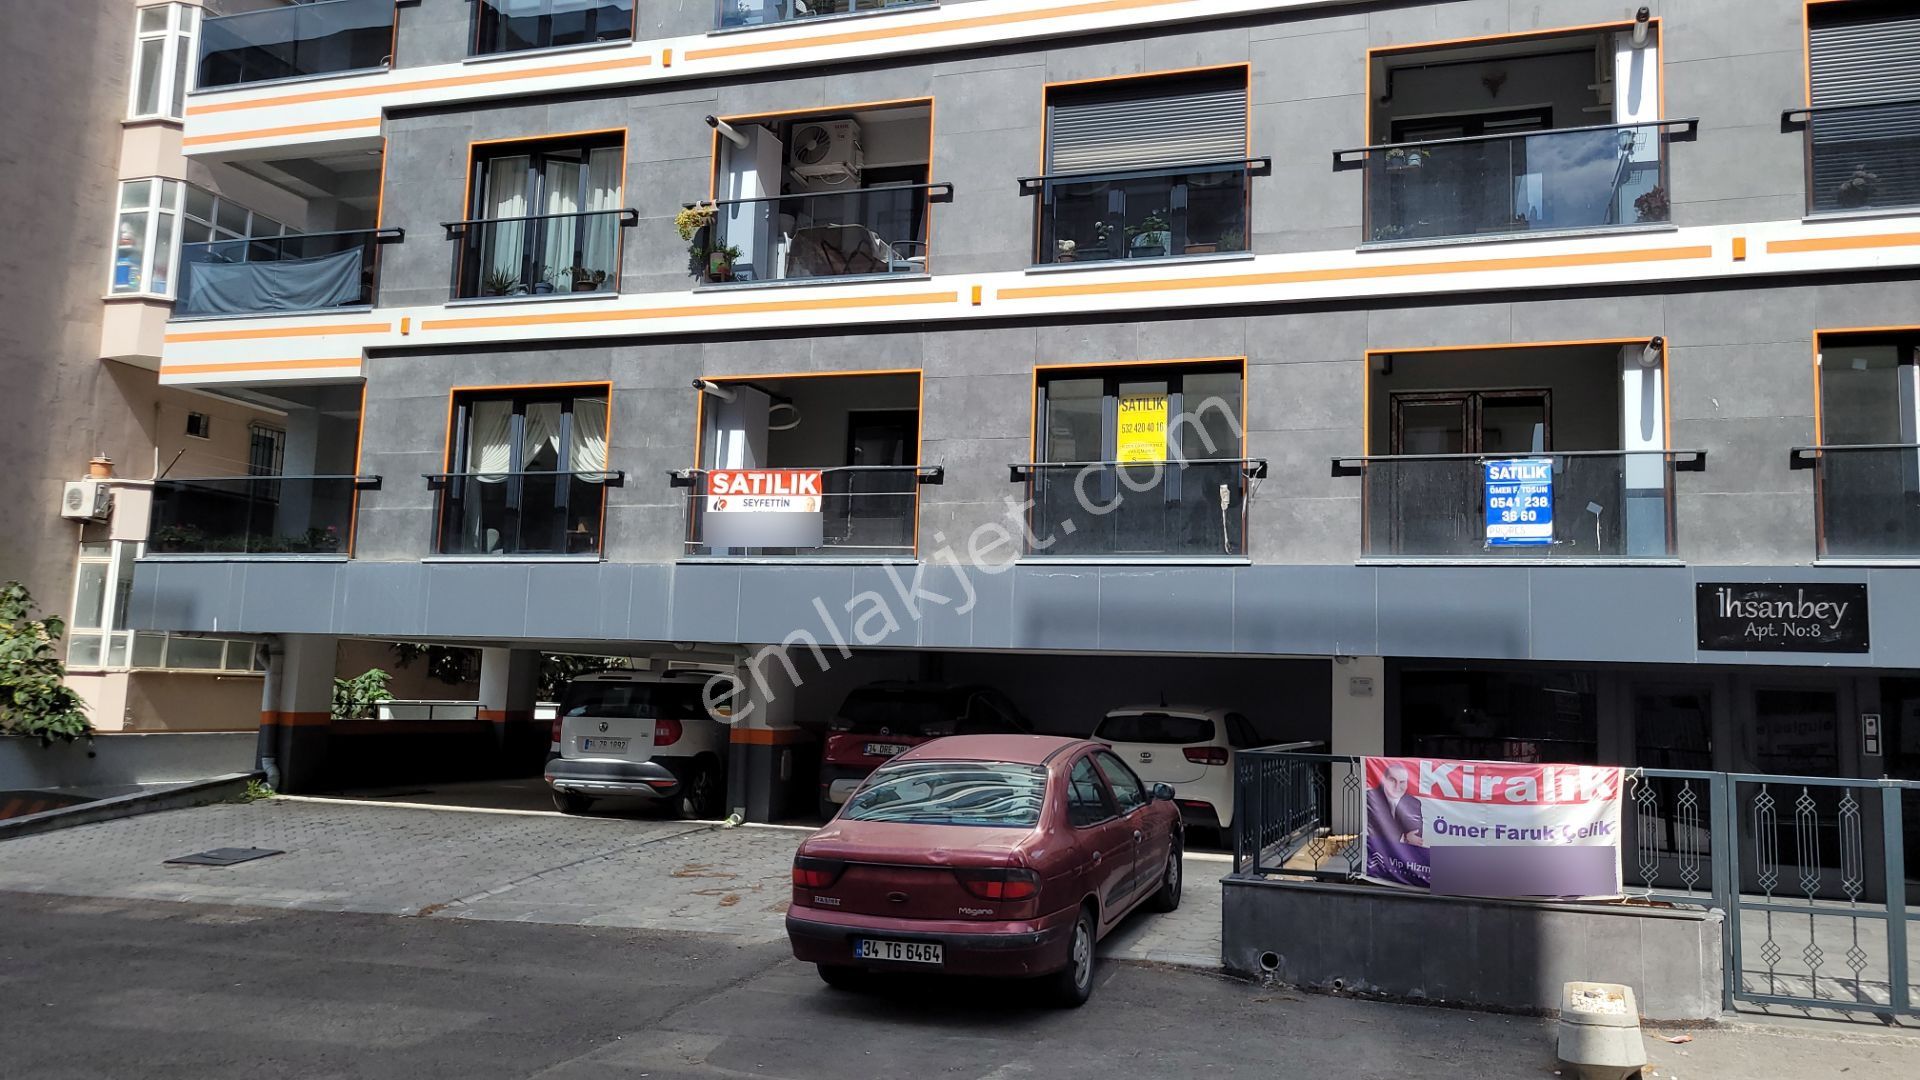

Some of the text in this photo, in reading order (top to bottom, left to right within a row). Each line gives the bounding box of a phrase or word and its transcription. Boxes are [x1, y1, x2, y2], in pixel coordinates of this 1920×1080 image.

[1121, 396, 1164, 412] SATILIK
[1121, 423, 1133, 434] 532
[1133, 422, 1145, 433] 420
[1489, 466, 1547, 480] SATILIK
[713, 473, 819, 495] SATILIK
[1489, 485, 1512, 494] ÖMER
[743, 497, 791, 507] SEYFETTİN
[1490, 496, 1548, 508] 0541 238
[1520, 510, 1537, 521] 60
[1744, 621, 1821, 641] Apt. No:8
[868, 744, 877, 753] 34
[1419, 761, 1614, 802] Kiralık
[1433, 816, 1612, 844] Ömer Faruk Çelik
[1389, 857, 1404, 869] Vip
[863, 940, 940, 962] 34 TG 6464
